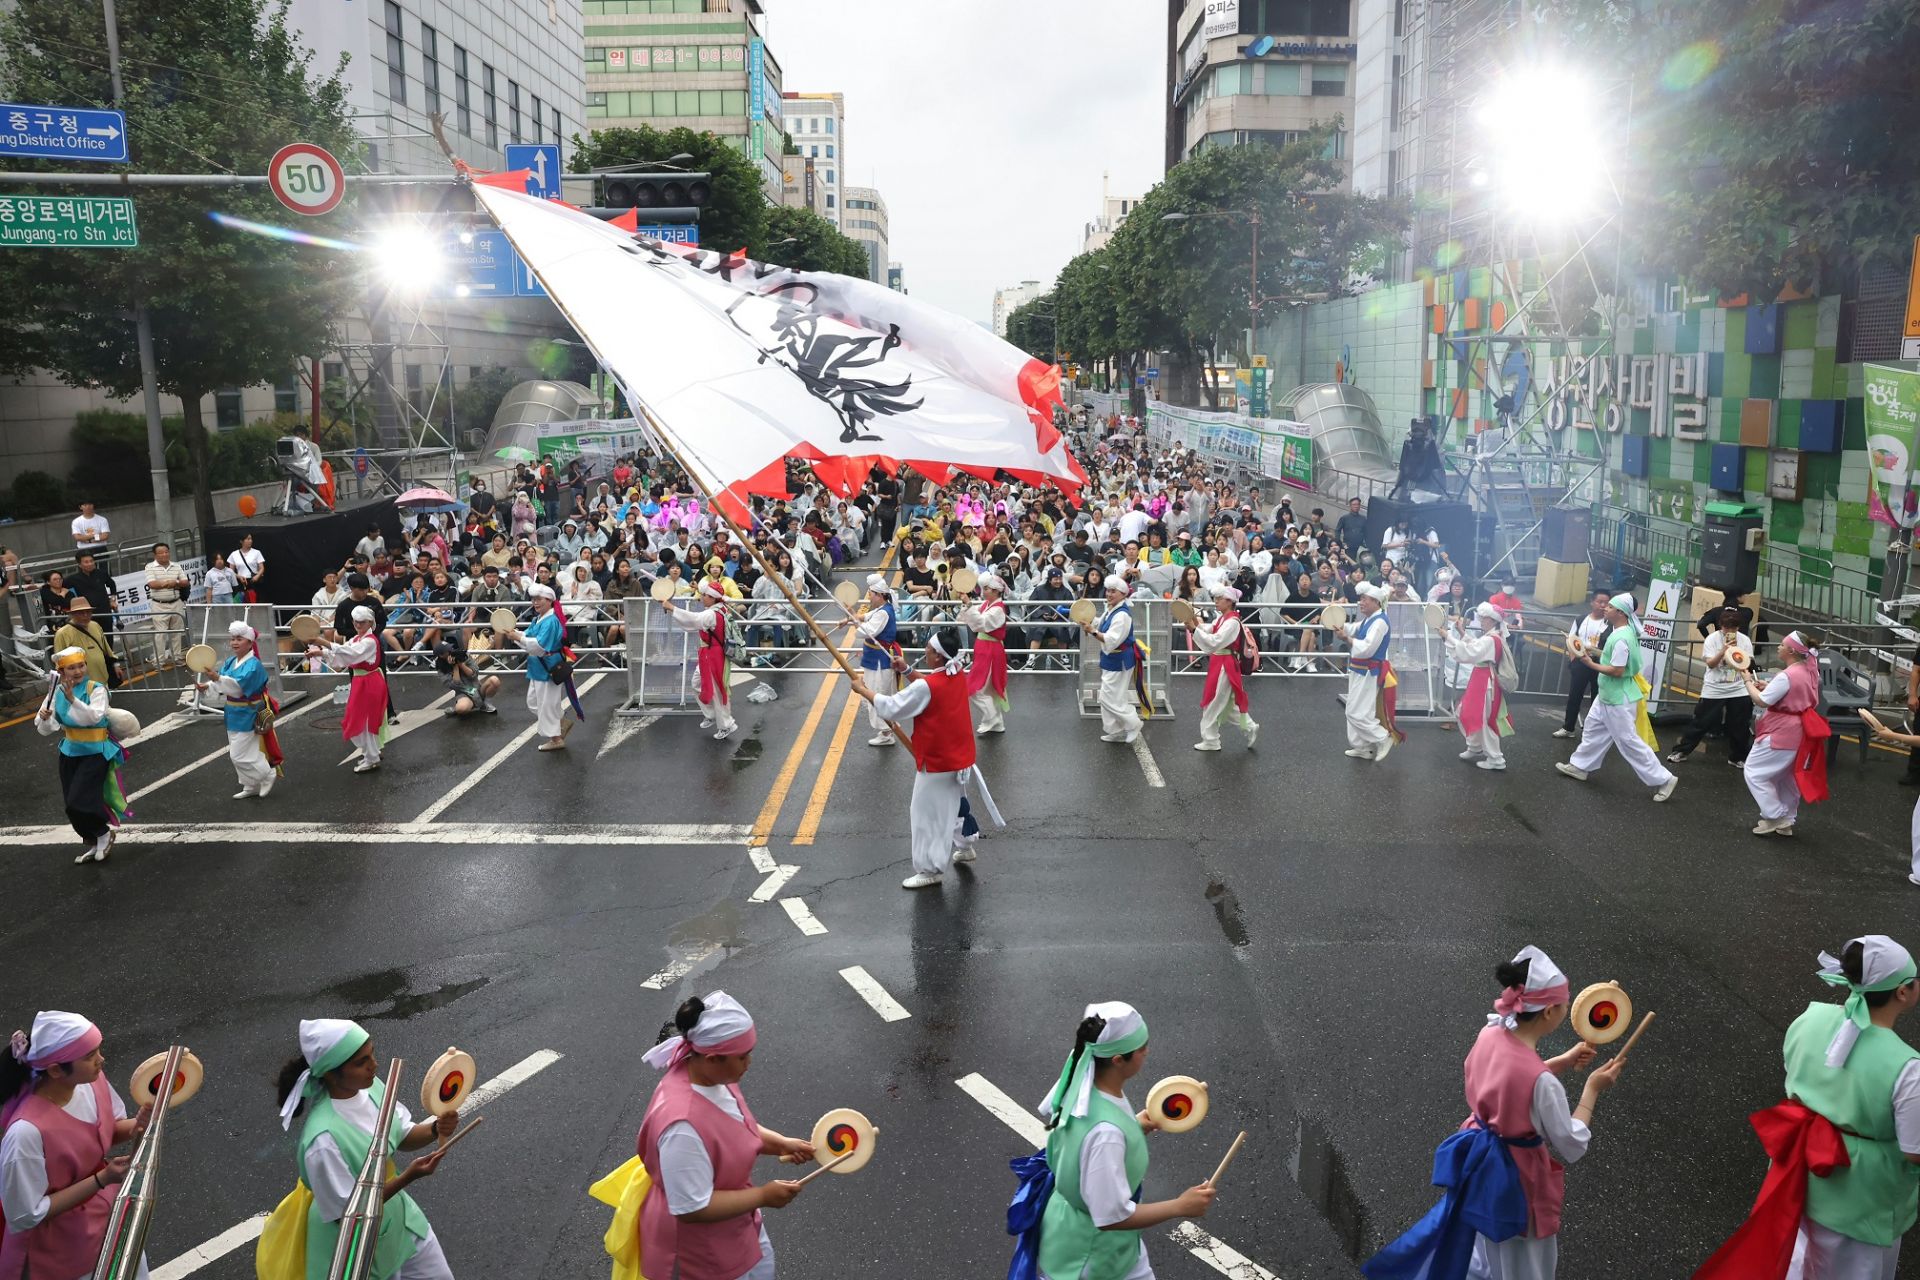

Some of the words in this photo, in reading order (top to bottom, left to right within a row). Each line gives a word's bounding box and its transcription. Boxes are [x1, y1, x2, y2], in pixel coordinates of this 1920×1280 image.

[1207, 0, 1236, 15] 오피스
[9, 111, 78, 134] 중구청
[19, 133, 65, 148] District
[67, 136, 106, 150] Office
[286, 164, 325, 194] 50
[0, 198, 131, 225] 중앙로역네거리
[1, 225, 78, 243] Jungang-ro
[84, 226, 107, 241] Stn
[112, 227, 133, 241] Jct
[1542, 351, 1709, 441] 성원상떼빌
[1887, 398, 1916, 422] 축제
